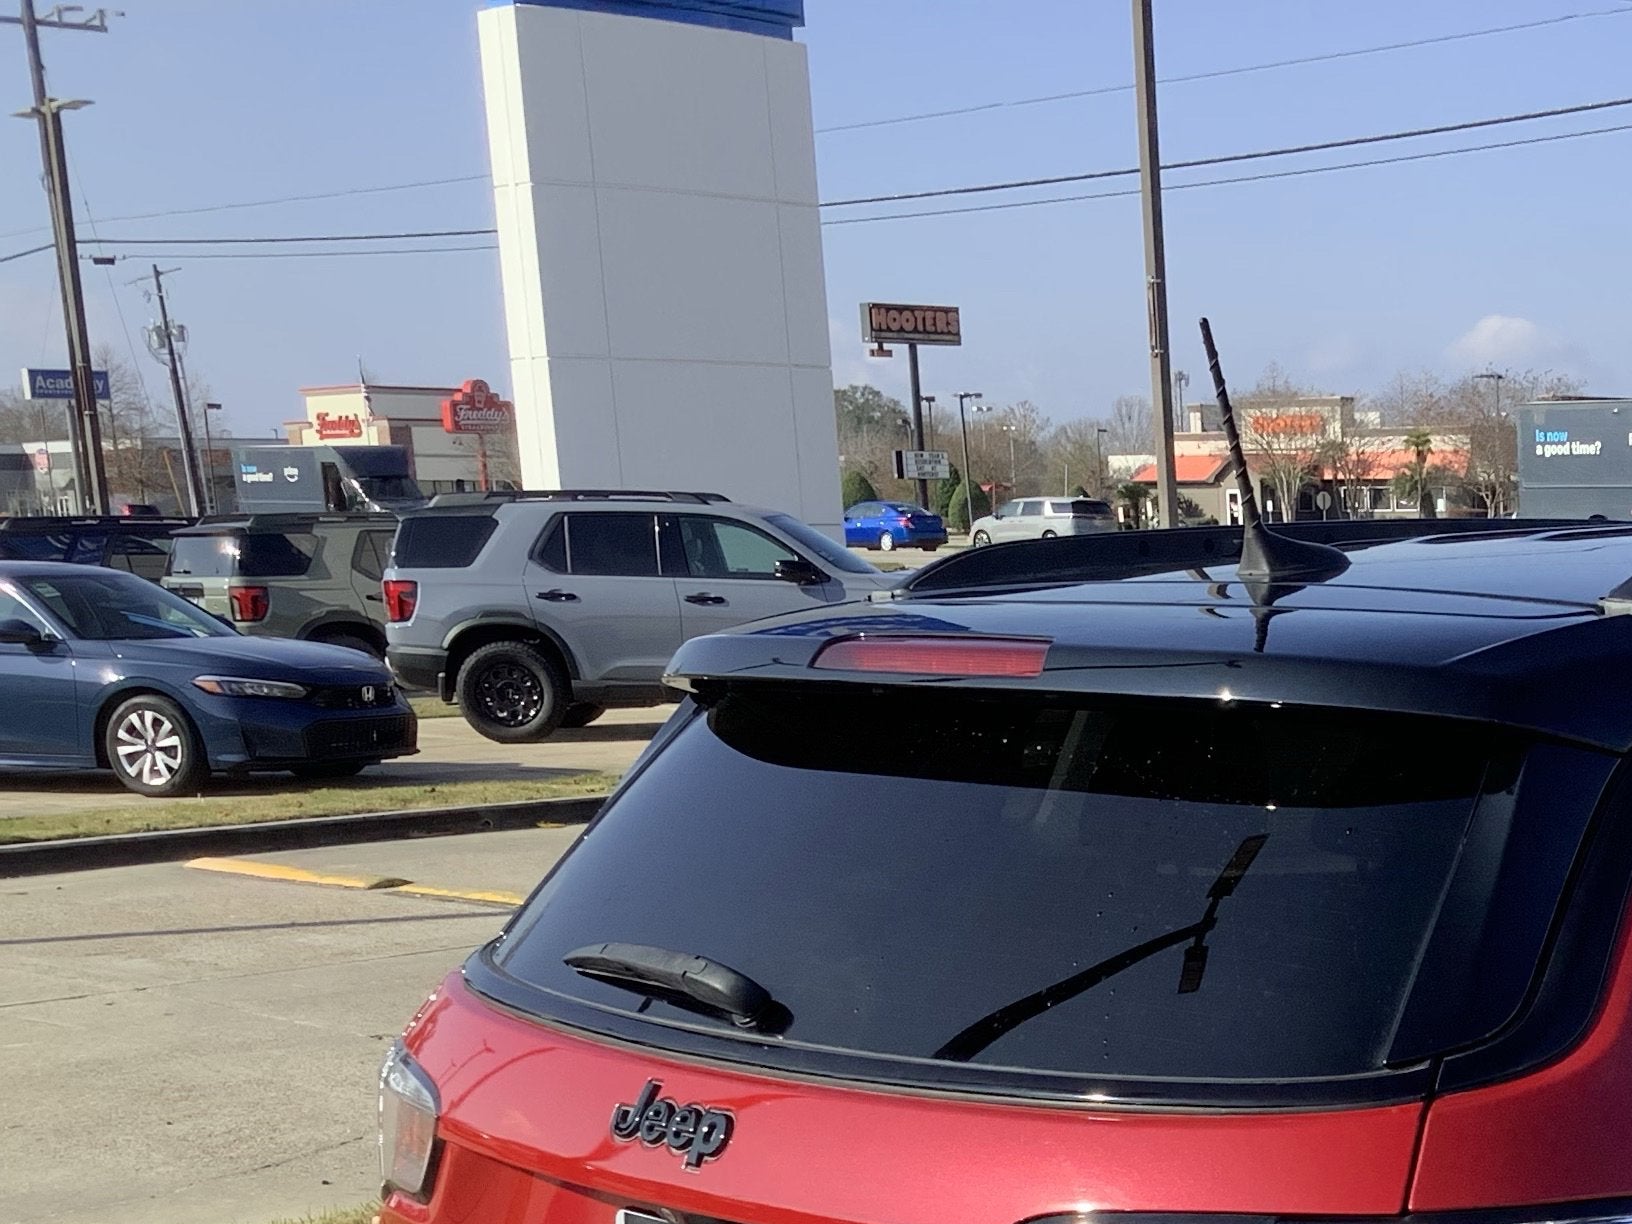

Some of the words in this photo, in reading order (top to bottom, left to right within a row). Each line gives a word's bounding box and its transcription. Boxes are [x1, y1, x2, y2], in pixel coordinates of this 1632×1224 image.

[871, 307, 959, 334] HOOTERS
[36, 375, 105, 394] Acady
[1546, 431, 1568, 442] now
[1544, 442, 1570, 457] good
[1571, 441, 1601, 456] time?
[612, 1078, 737, 1172] Jeep
